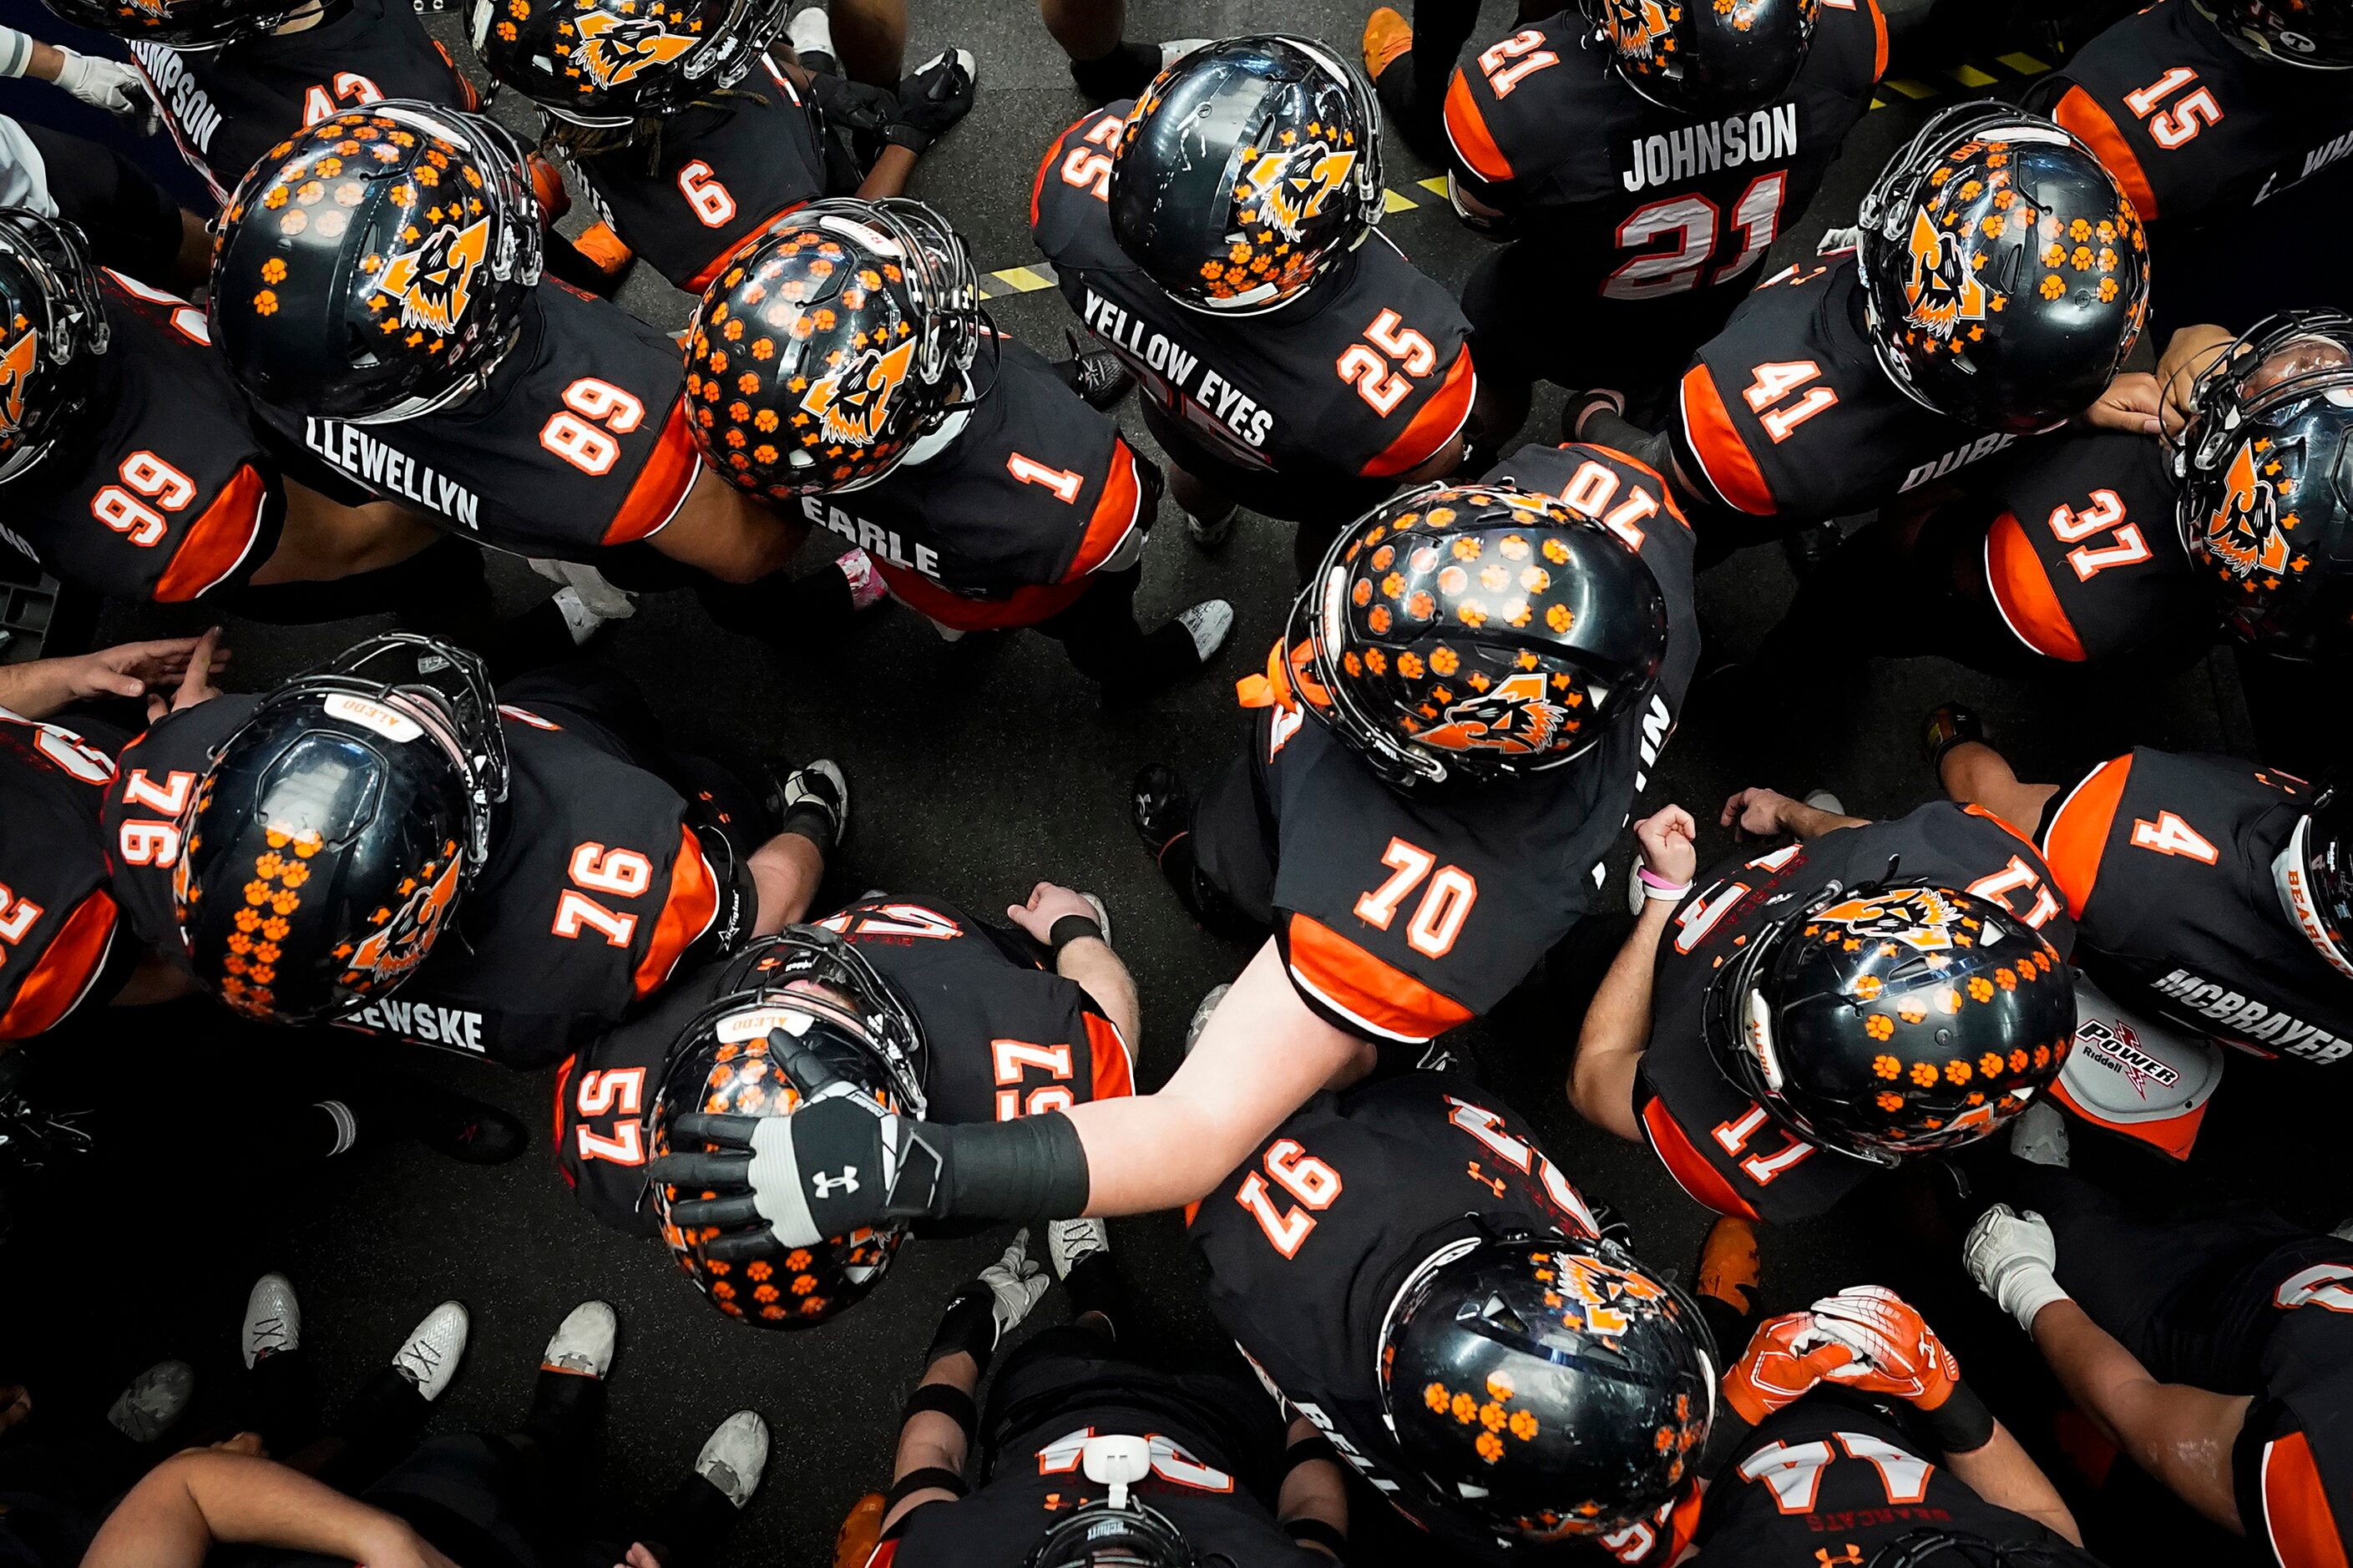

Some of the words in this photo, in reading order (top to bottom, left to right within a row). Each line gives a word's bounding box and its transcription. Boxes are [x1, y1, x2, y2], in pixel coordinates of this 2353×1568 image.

[124, 38, 221, 154] OMPSON
[1477, 29, 1561, 101] 21
[2123, 67, 2225, 151] 15
[677, 159, 737, 229] 6
[1623, 103, 1796, 193] JOHNSON
[1598, 169, 1789, 301] 21
[1085, 287, 1199, 387] YELLOW
[1196, 369, 1273, 446] EYES
[1336, 306, 1437, 418] 25
[1743, 360, 1839, 444] 41
[306, 416, 478, 530] LLEWELLYN
[539, 377, 646, 477] 89
[90, 449, 197, 548] 99
[1005, 452, 1085, 505] 1
[1559, 460, 1660, 553] 70
[801, 496, 941, 579] EARLE
[2047, 488, 2154, 582] 37
[342, 700, 401, 727] ALEDO
[119, 769, 197, 868] 76
[2131, 810, 2219, 866] 4
[551, 840, 654, 948] 76
[1352, 836, 1478, 960] 70
[347, 999, 485, 1053] EWSKE
[2075, 1019, 2179, 1086] POWER
[2082, 1045, 2123, 1074] Riddell
[2149, 969, 2353, 1065] MCBRAYER
[576, 1066, 647, 1167] 57
[1235, 1138, 1343, 1261] 97
